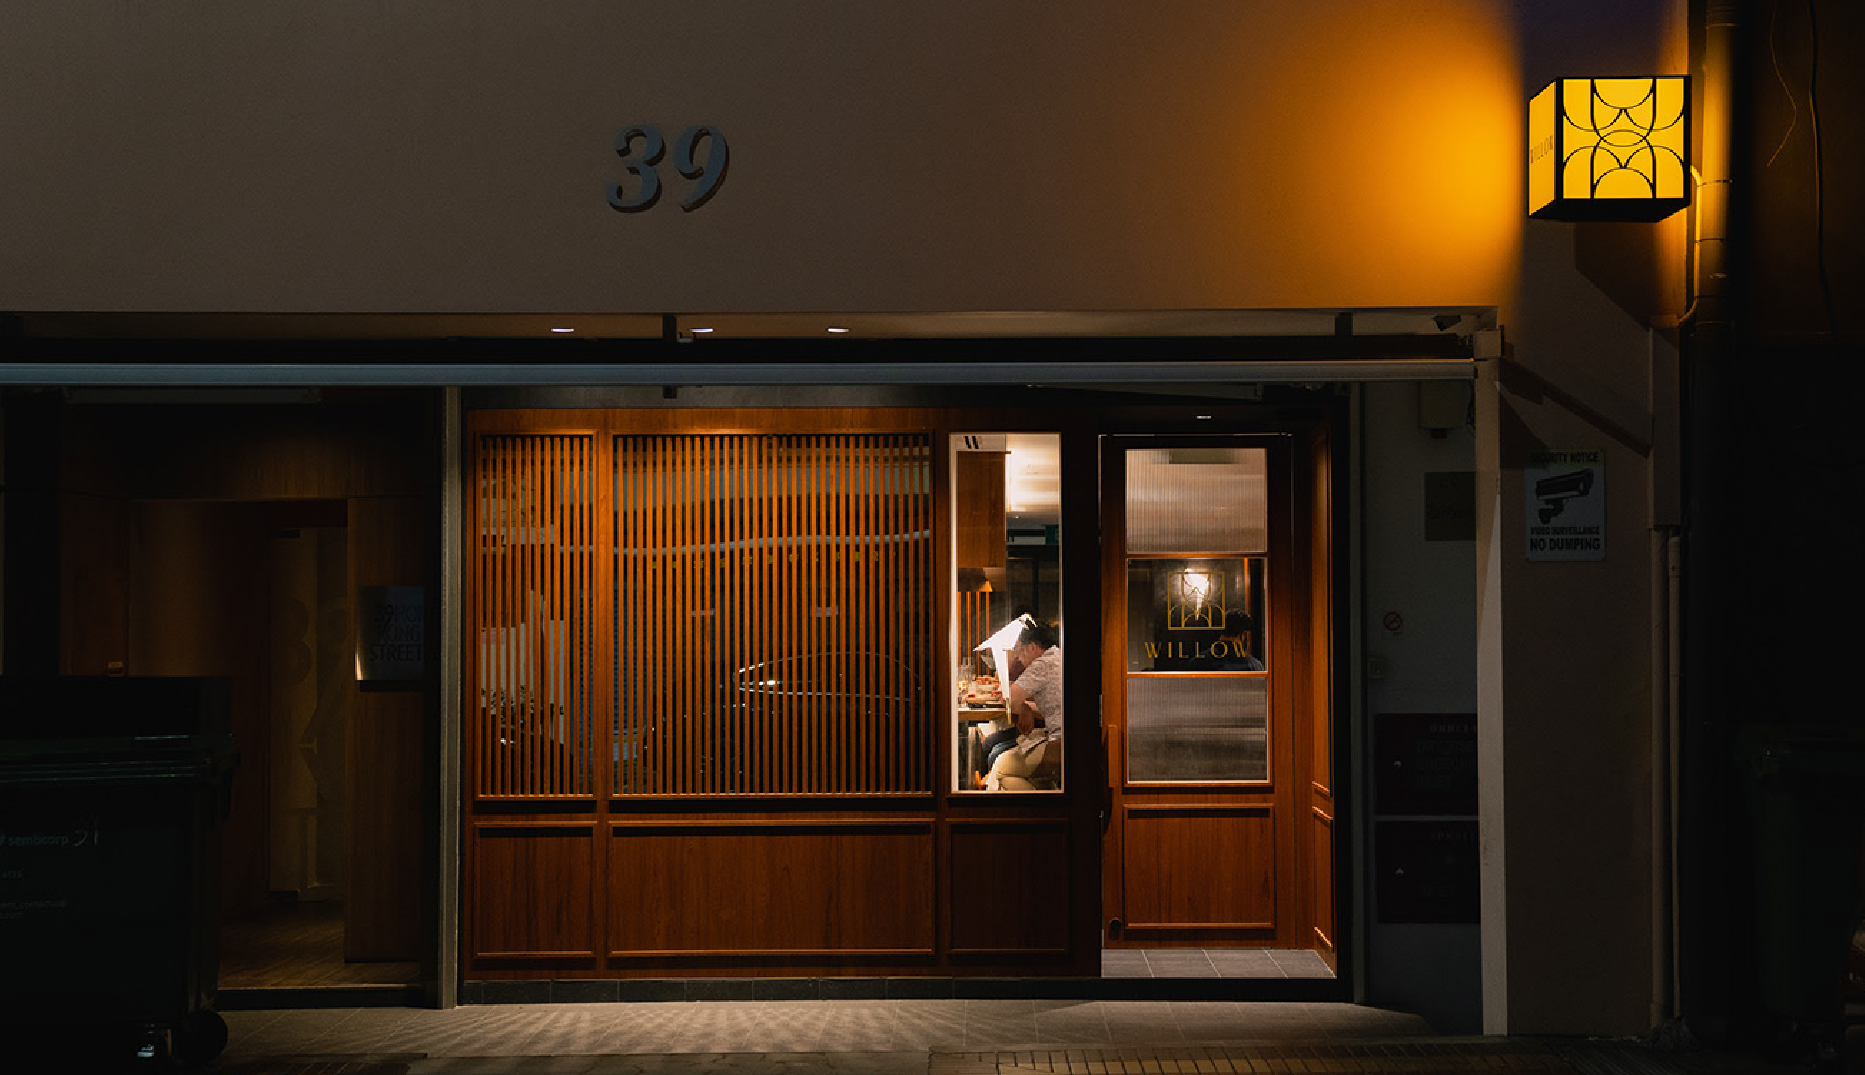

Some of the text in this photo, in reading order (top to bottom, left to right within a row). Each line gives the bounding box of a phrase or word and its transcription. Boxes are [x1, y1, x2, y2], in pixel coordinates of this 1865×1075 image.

[606, 125, 730, 214] 39
[1530, 451, 1600, 462] SECURITY NOTICE
[1530, 538, 1600, 551] NO DUMPING
[369, 643, 422, 662] STREET
[1144, 641, 1248, 659] WILLOW
[8, 834, 70, 847] sembcorp
